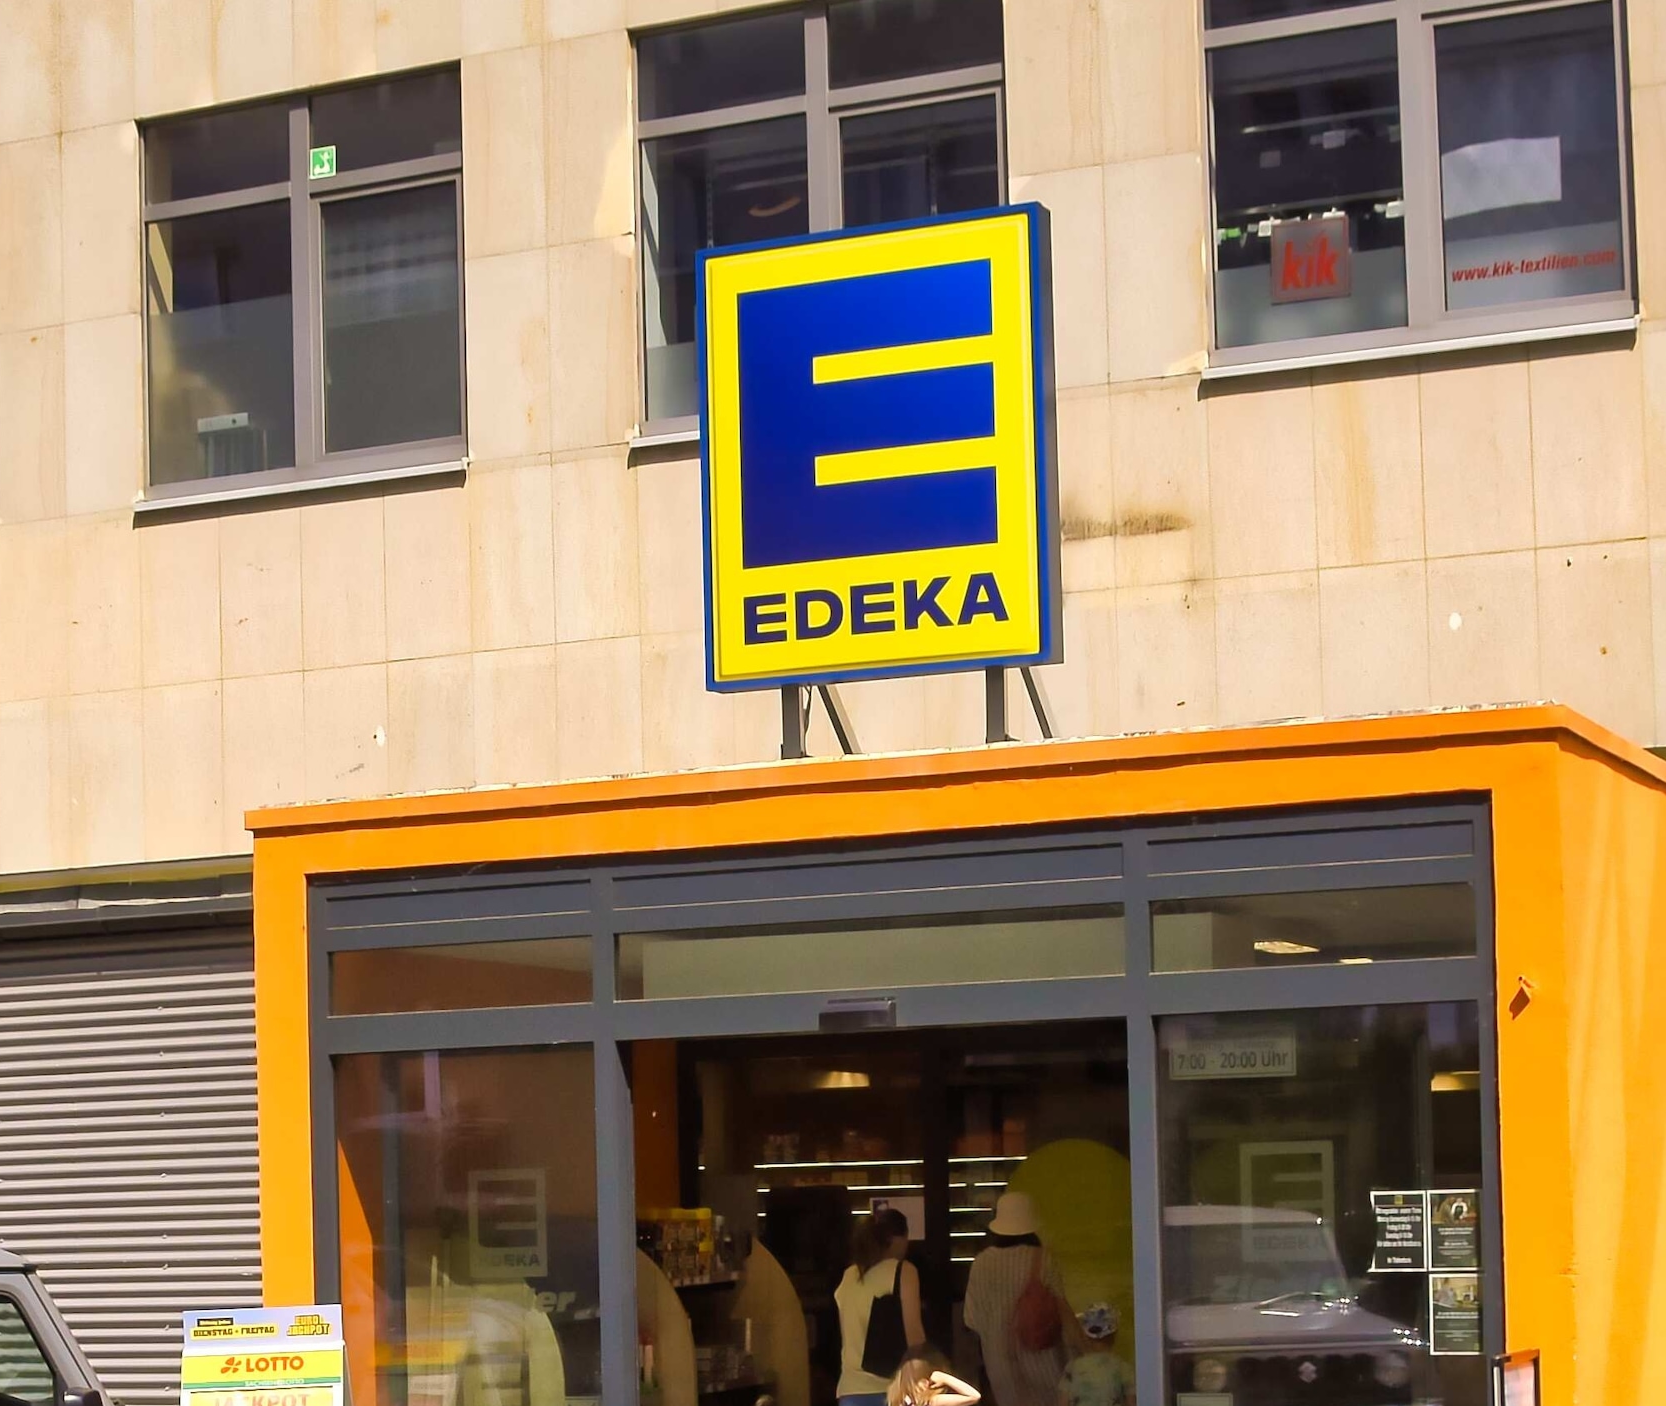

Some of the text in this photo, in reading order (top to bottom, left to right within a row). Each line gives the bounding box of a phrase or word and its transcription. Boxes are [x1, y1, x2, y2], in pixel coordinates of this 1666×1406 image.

[1280, 231, 1341, 291] kik
[1451, 244, 1617, 283] www.kik-textilien.com
[743, 571, 1009, 646] EDEKA
[246, 1356, 304, 1373] LOTTO
